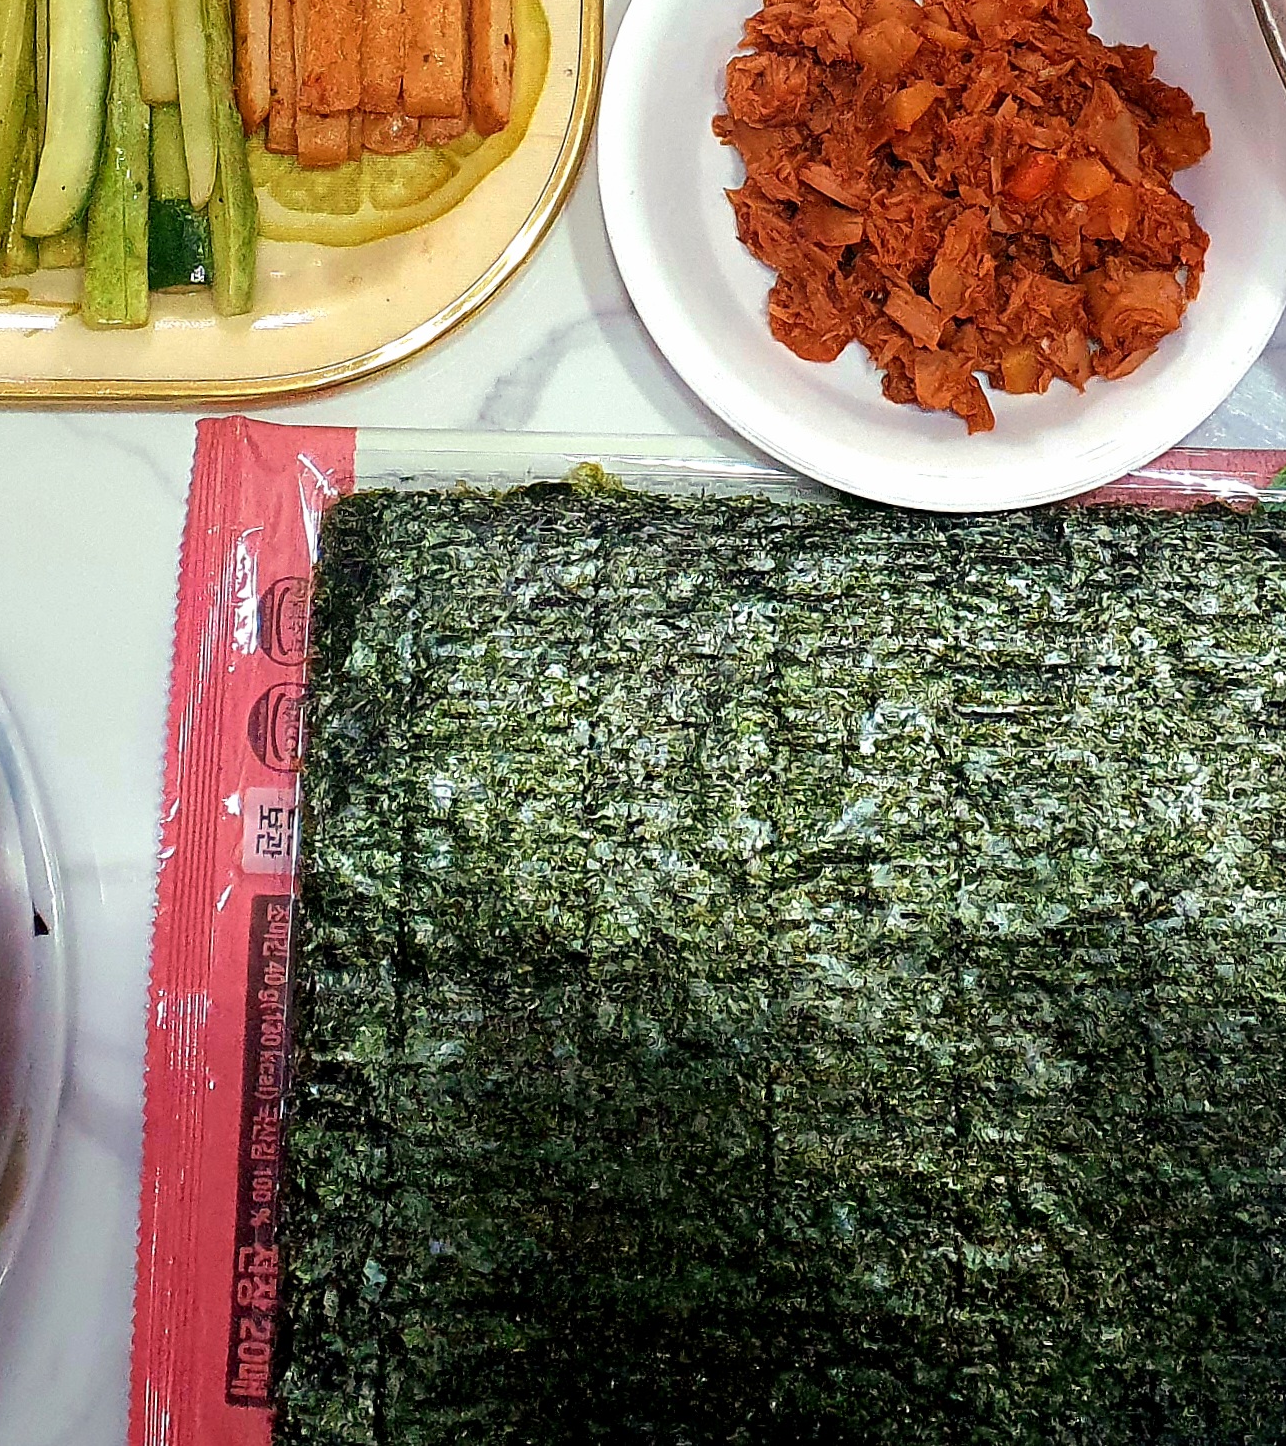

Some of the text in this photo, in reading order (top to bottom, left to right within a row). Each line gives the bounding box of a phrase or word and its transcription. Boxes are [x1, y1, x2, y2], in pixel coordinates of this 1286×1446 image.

[256, 804, 284, 858] 보관
[264, 960, 288, 986] 40
[230, 1317, 273, 1398] 20매
